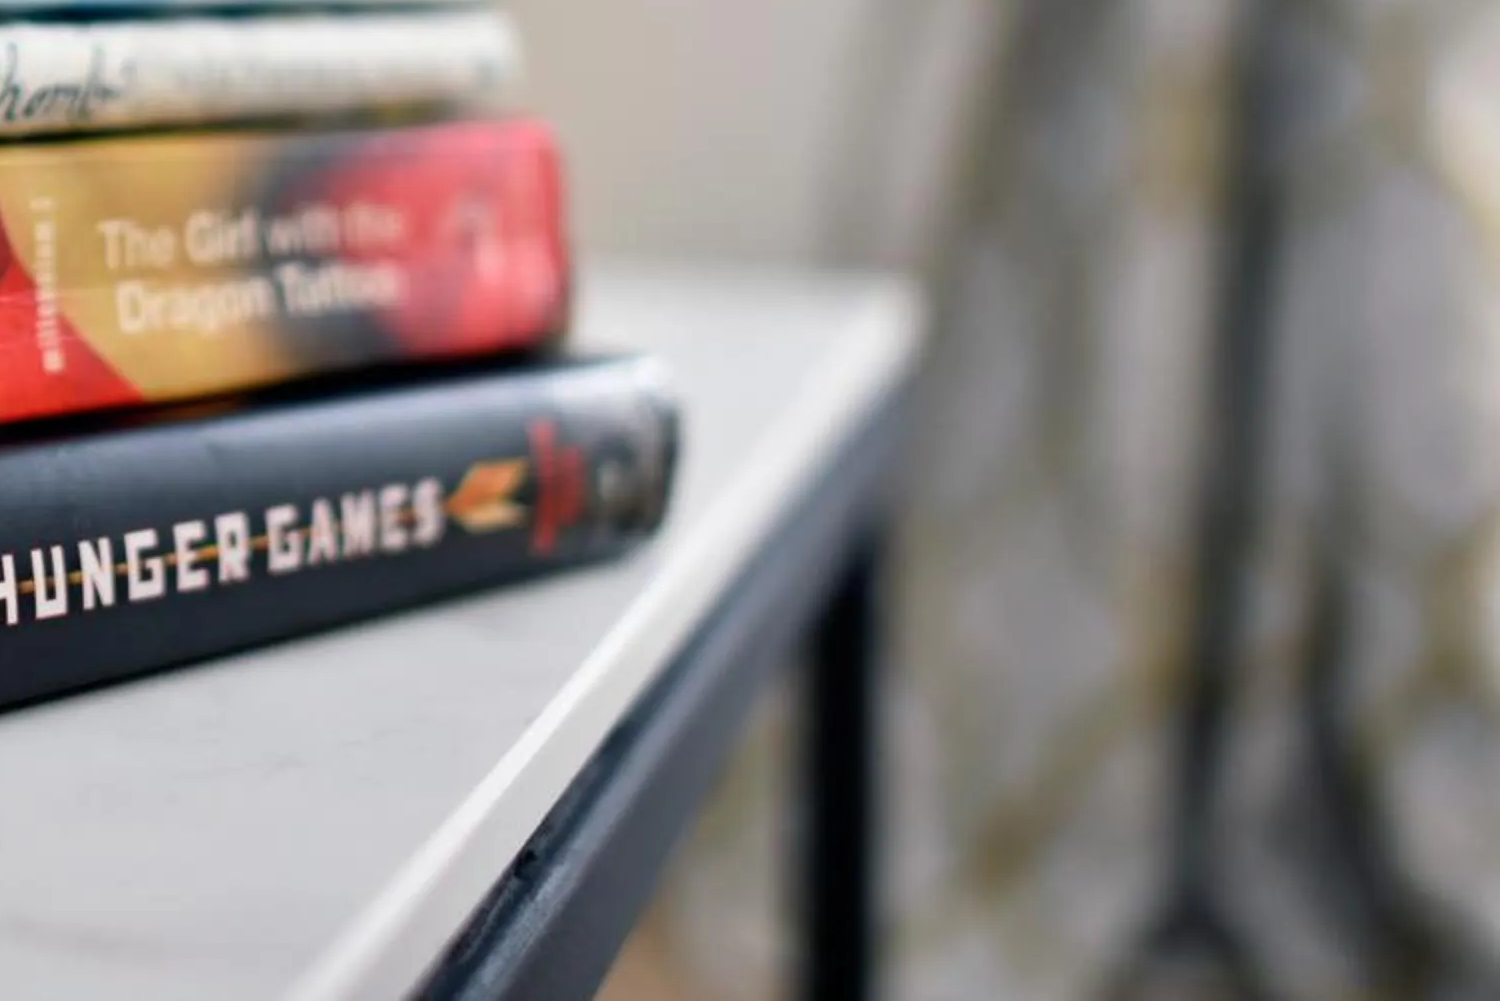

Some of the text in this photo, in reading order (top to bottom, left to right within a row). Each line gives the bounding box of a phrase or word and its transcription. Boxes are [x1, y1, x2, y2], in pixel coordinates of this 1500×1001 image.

[96, 218, 174, 271] The
[184, 207, 259, 264] Girl
[115, 277, 270, 337] Dragon
[265, 476, 446, 574] GAMES
